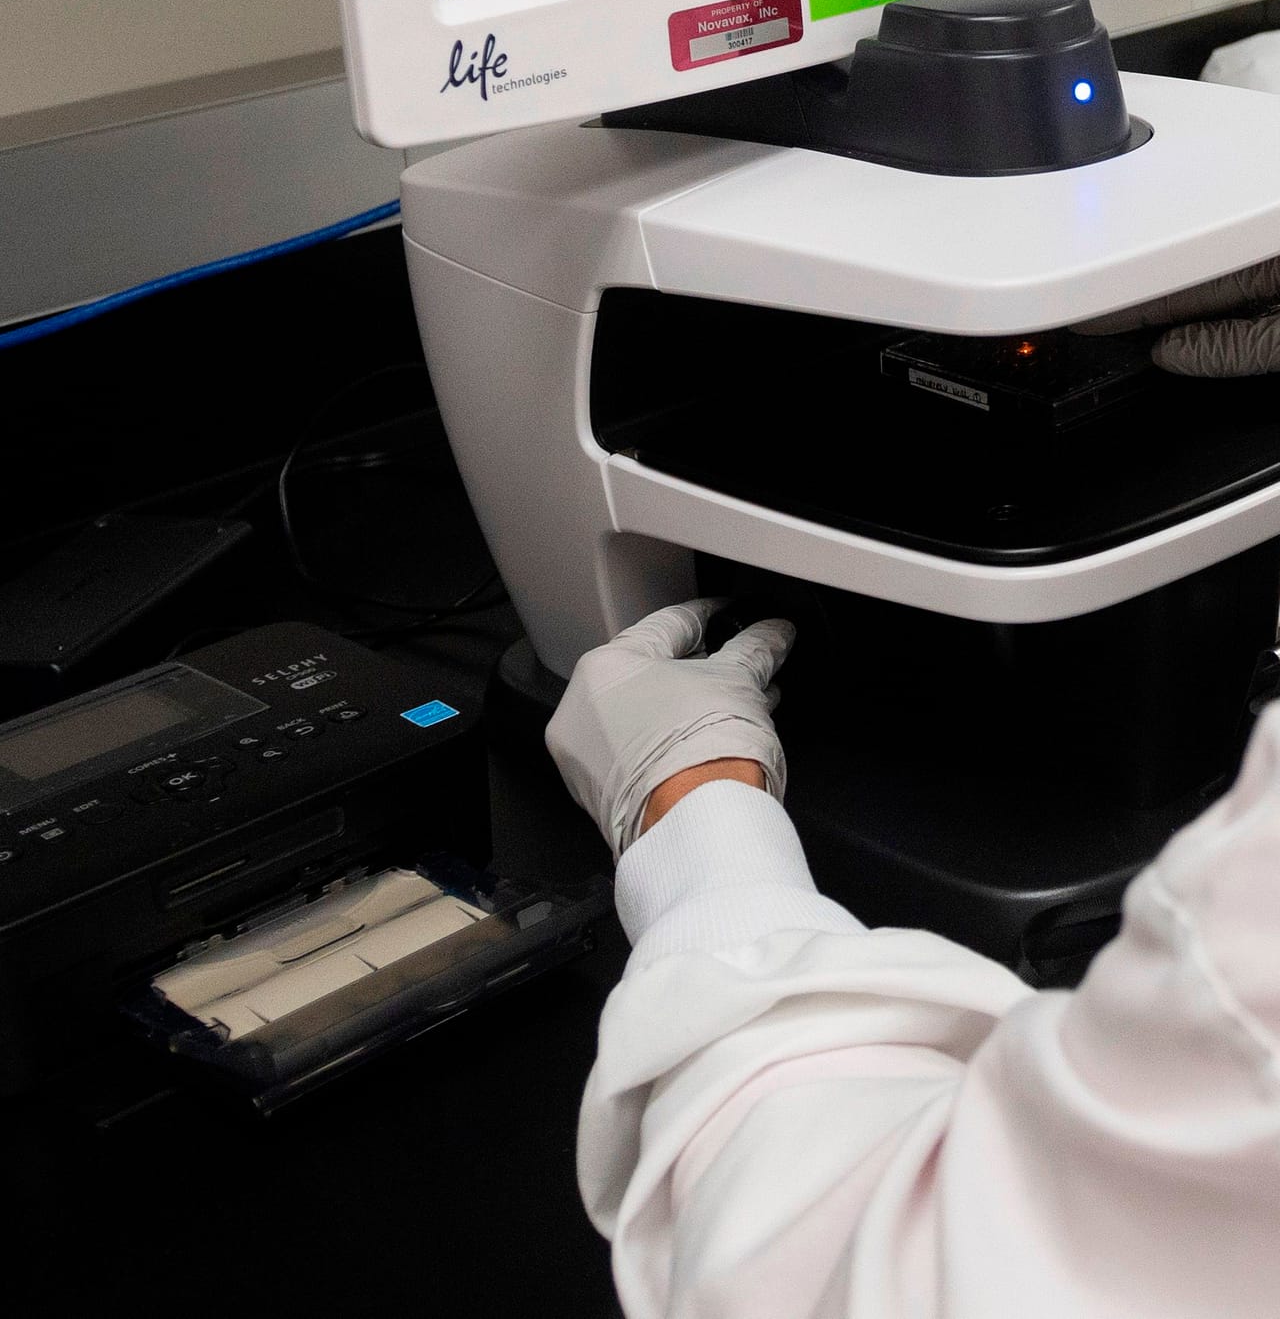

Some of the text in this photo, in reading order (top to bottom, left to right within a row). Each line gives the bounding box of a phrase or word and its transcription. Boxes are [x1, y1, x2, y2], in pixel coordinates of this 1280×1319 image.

[711, 0, 764, 17] PROPERTY OF
[697, 12, 753, 33] Novavax,
[728, 37, 753, 50] 300417
[440, 33, 508, 101] life
[491, 67, 568, 95] technologies
[251, 653, 328, 686] SELPHY
[276, 718, 306, 731] BACK
[168, 770, 198, 786] OK
[72, 798, 101, 813] EDIT
[18, 817, 57, 835] MENU
